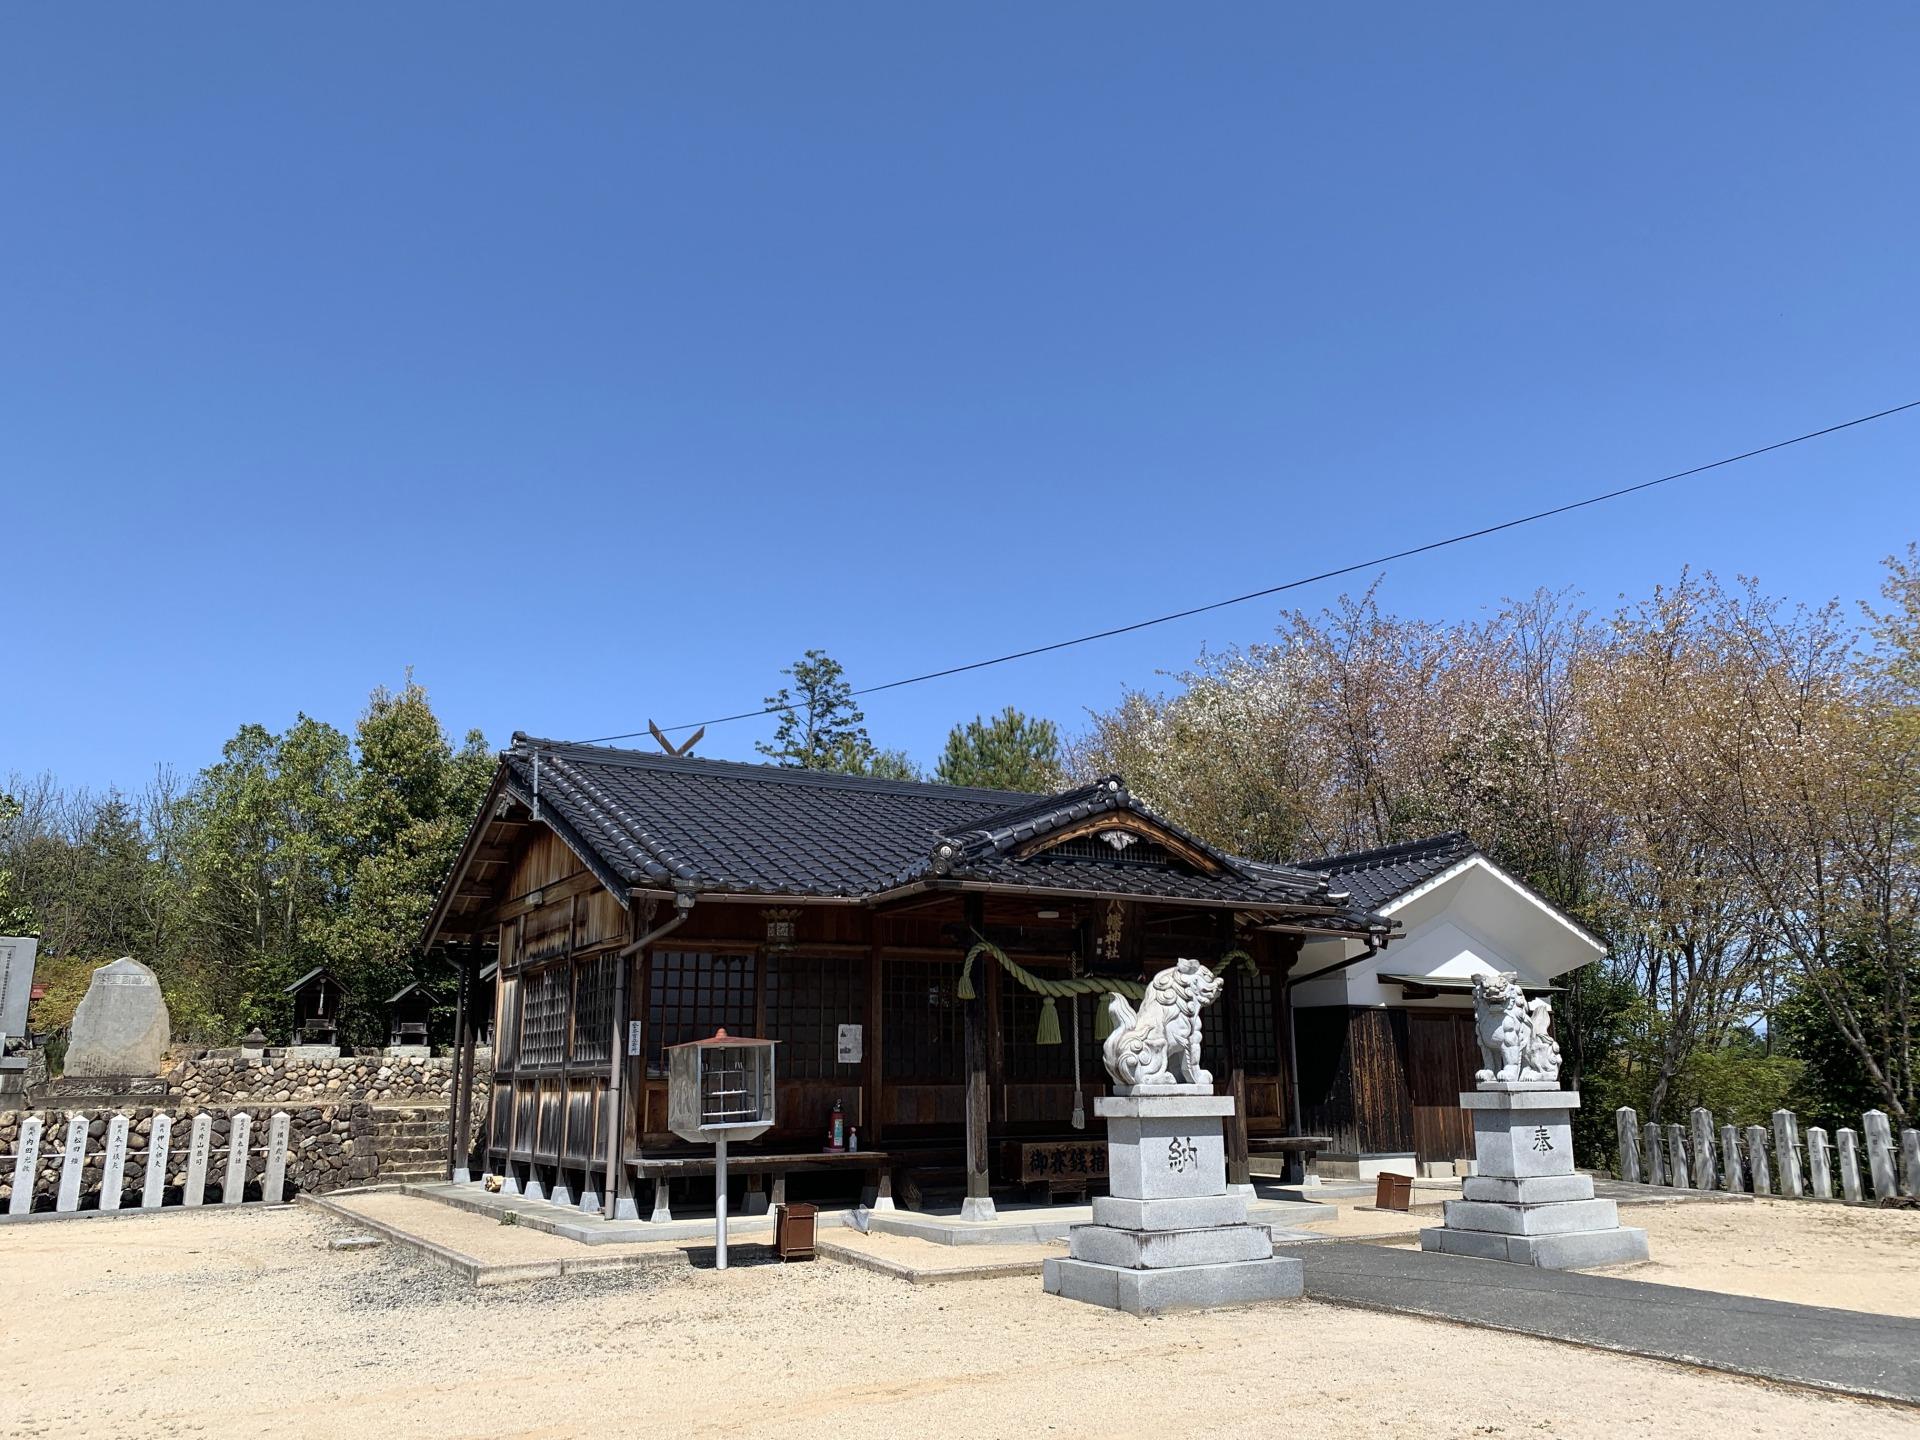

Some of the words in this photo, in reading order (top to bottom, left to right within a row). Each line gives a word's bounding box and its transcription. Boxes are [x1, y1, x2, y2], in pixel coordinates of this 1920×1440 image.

[1168, 1136, 1198, 1174] 納
[1533, 1125, 1554, 1156] 奉
[1030, 1145, 1106, 1177] 御賽銭箱
